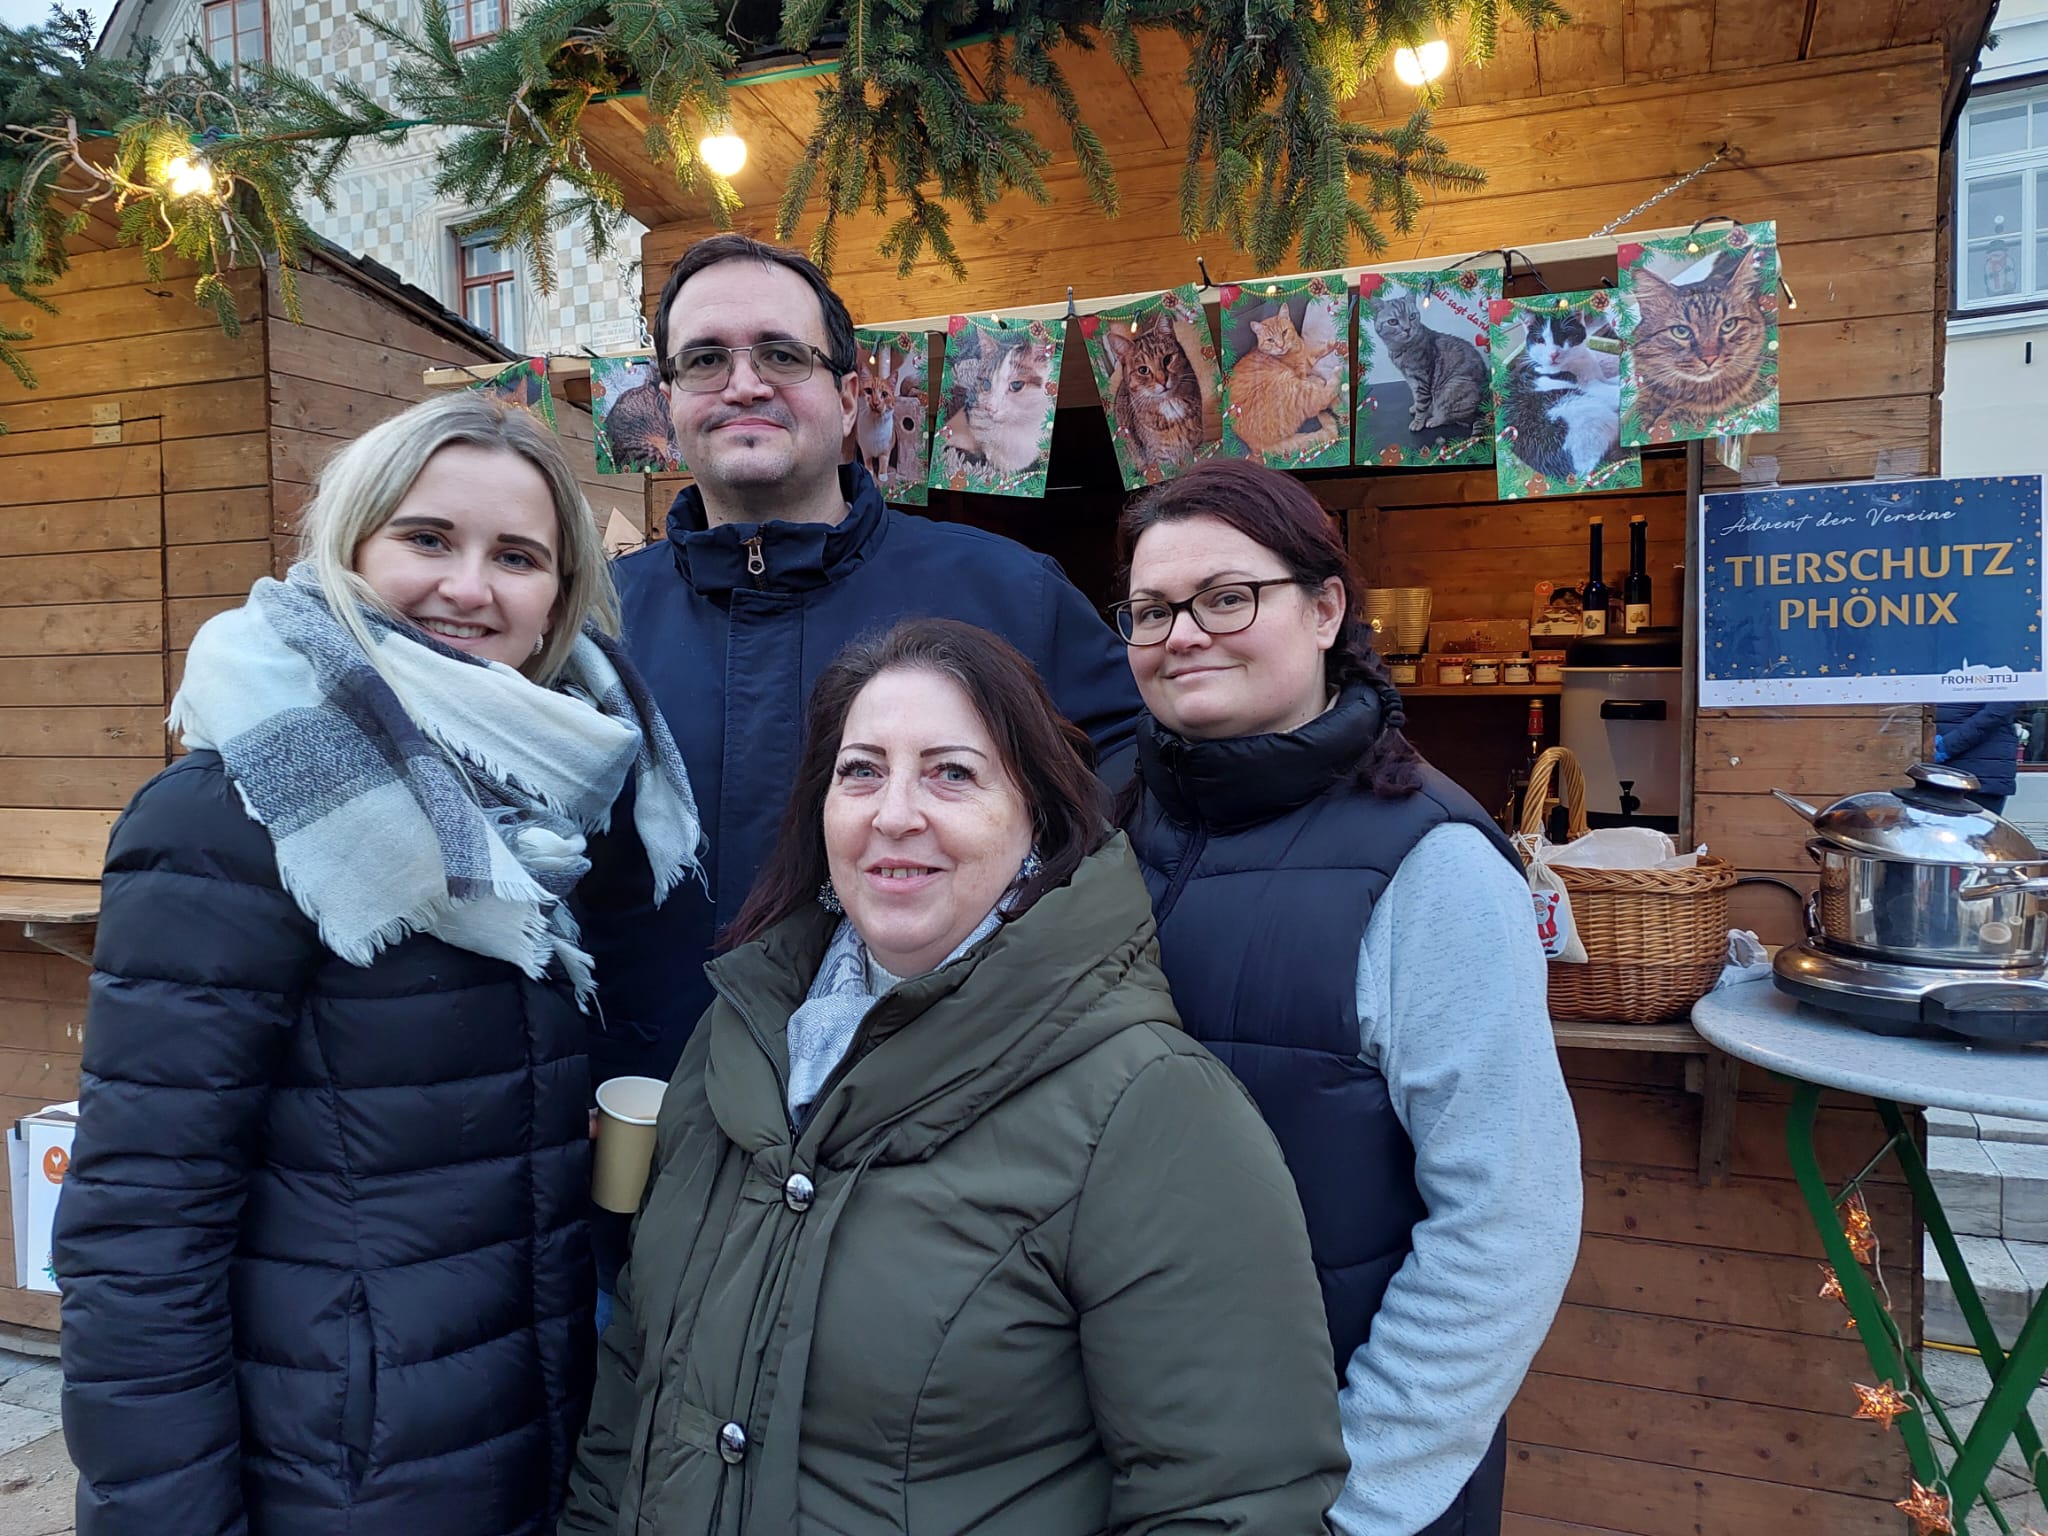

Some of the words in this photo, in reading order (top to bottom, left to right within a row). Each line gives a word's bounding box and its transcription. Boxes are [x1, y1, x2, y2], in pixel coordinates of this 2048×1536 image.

[1446, 299, 1469, 316] sagt
[1720, 513, 1813, 536] Advent
[1815, 511, 1857, 528] der
[1866, 507, 1957, 527] Vereine
[1724, 542, 2015, 587] TIERSCHUTZ
[1779, 587, 1959, 631] PHÖNIX
